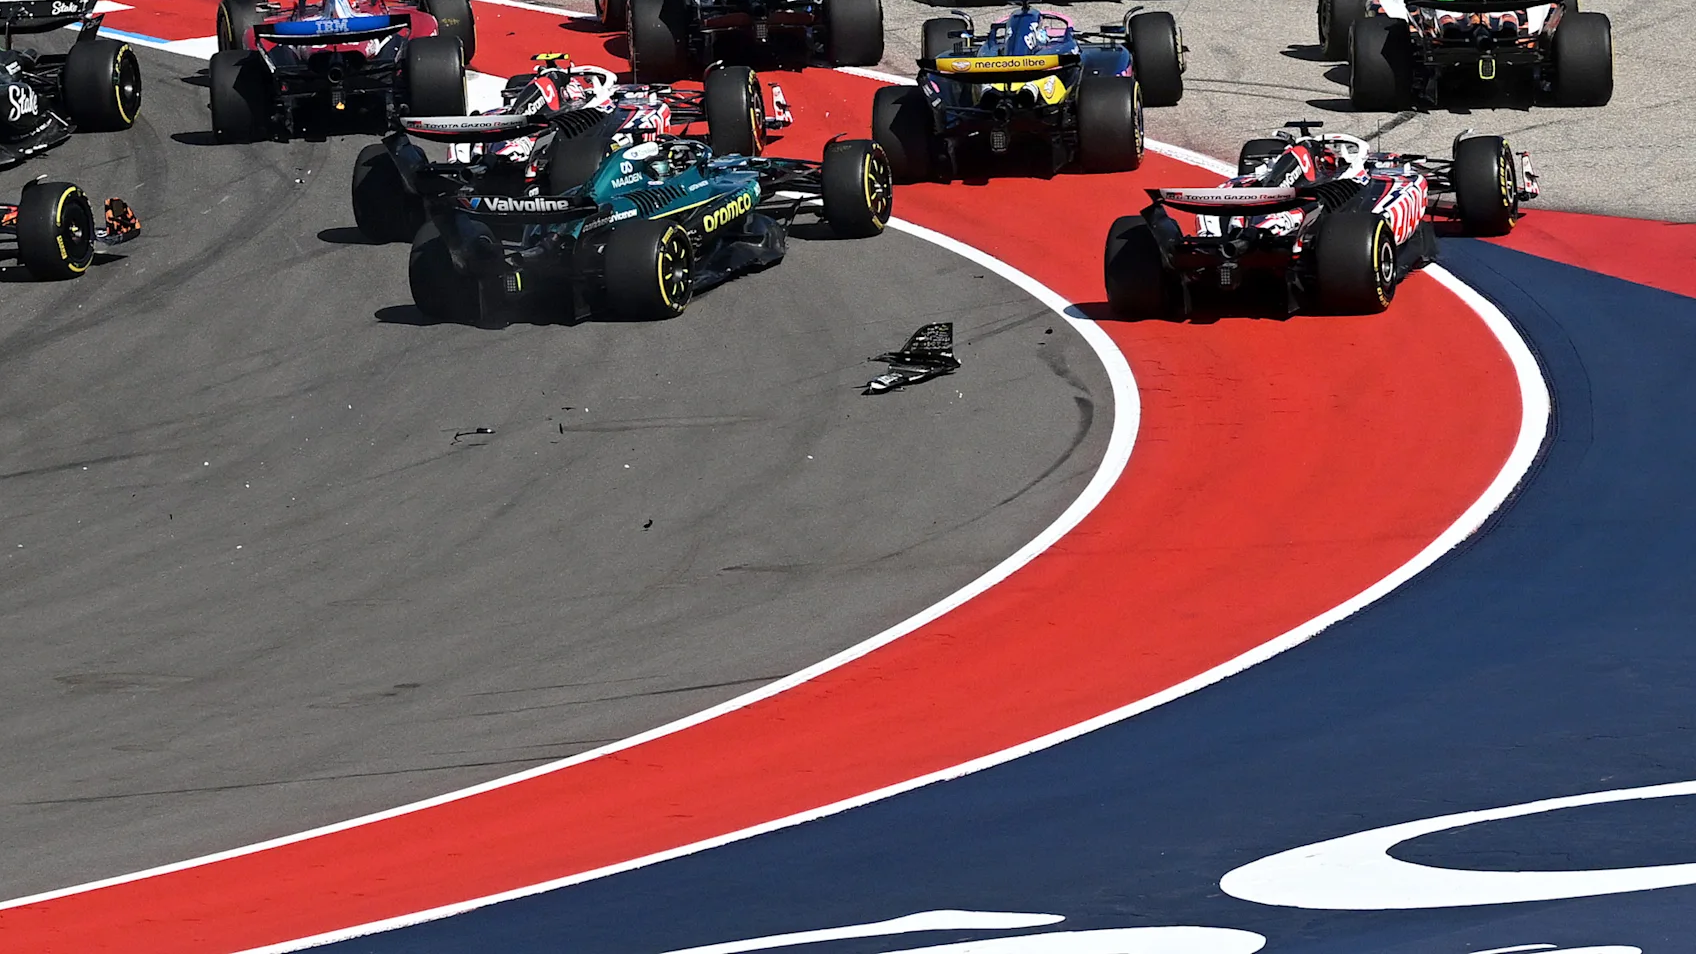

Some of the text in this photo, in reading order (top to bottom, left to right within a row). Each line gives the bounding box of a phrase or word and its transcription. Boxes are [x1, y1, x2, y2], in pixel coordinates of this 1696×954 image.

[52, 0, 78, 16] Stake
[315, 19, 350, 34] IBM
[974, 58, 1045, 69] mercado libre
[8, 84, 39, 122] Stake
[610, 171, 644, 189] MAADEN
[484, 197, 569, 212] Valvoline
[703, 192, 752, 233] aramco
